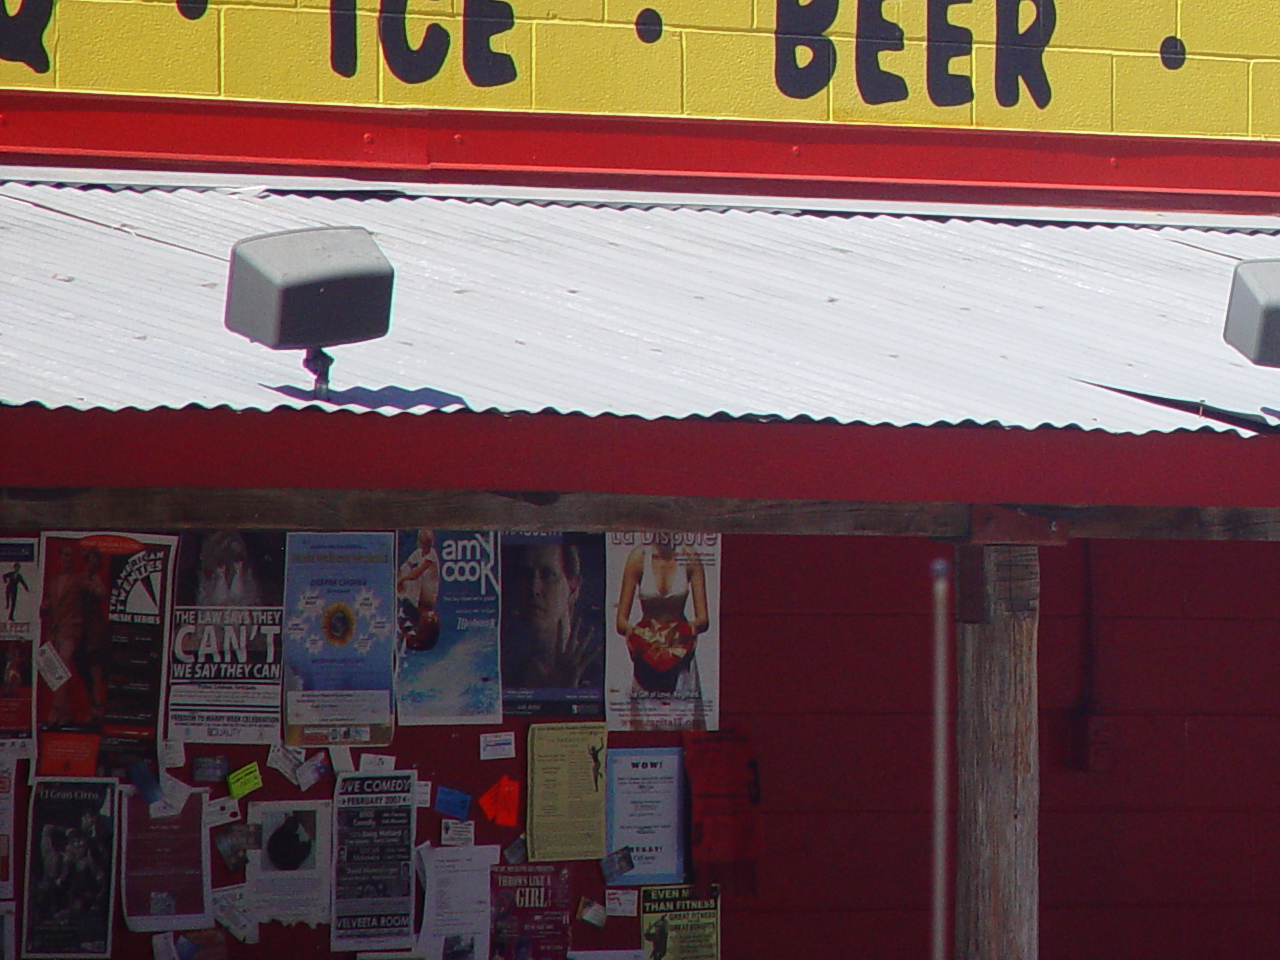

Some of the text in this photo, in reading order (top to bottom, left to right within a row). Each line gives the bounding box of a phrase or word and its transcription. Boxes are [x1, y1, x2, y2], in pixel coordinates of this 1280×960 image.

[441, 530, 495, 566] amy
[441, 561, 500, 596] cook
[175, 611, 281, 624] THE LAW SAYS THEY
[174, 625, 281, 663] CAN'T
[174, 664, 280, 679] WE SAY THEY CAN
[363, 780, 411, 792] COMEDY
[651, 889, 679, 899] EVEN
[644, 899, 716, 912] THAN FITNESS
[380, 915, 410, 927] ROOM
